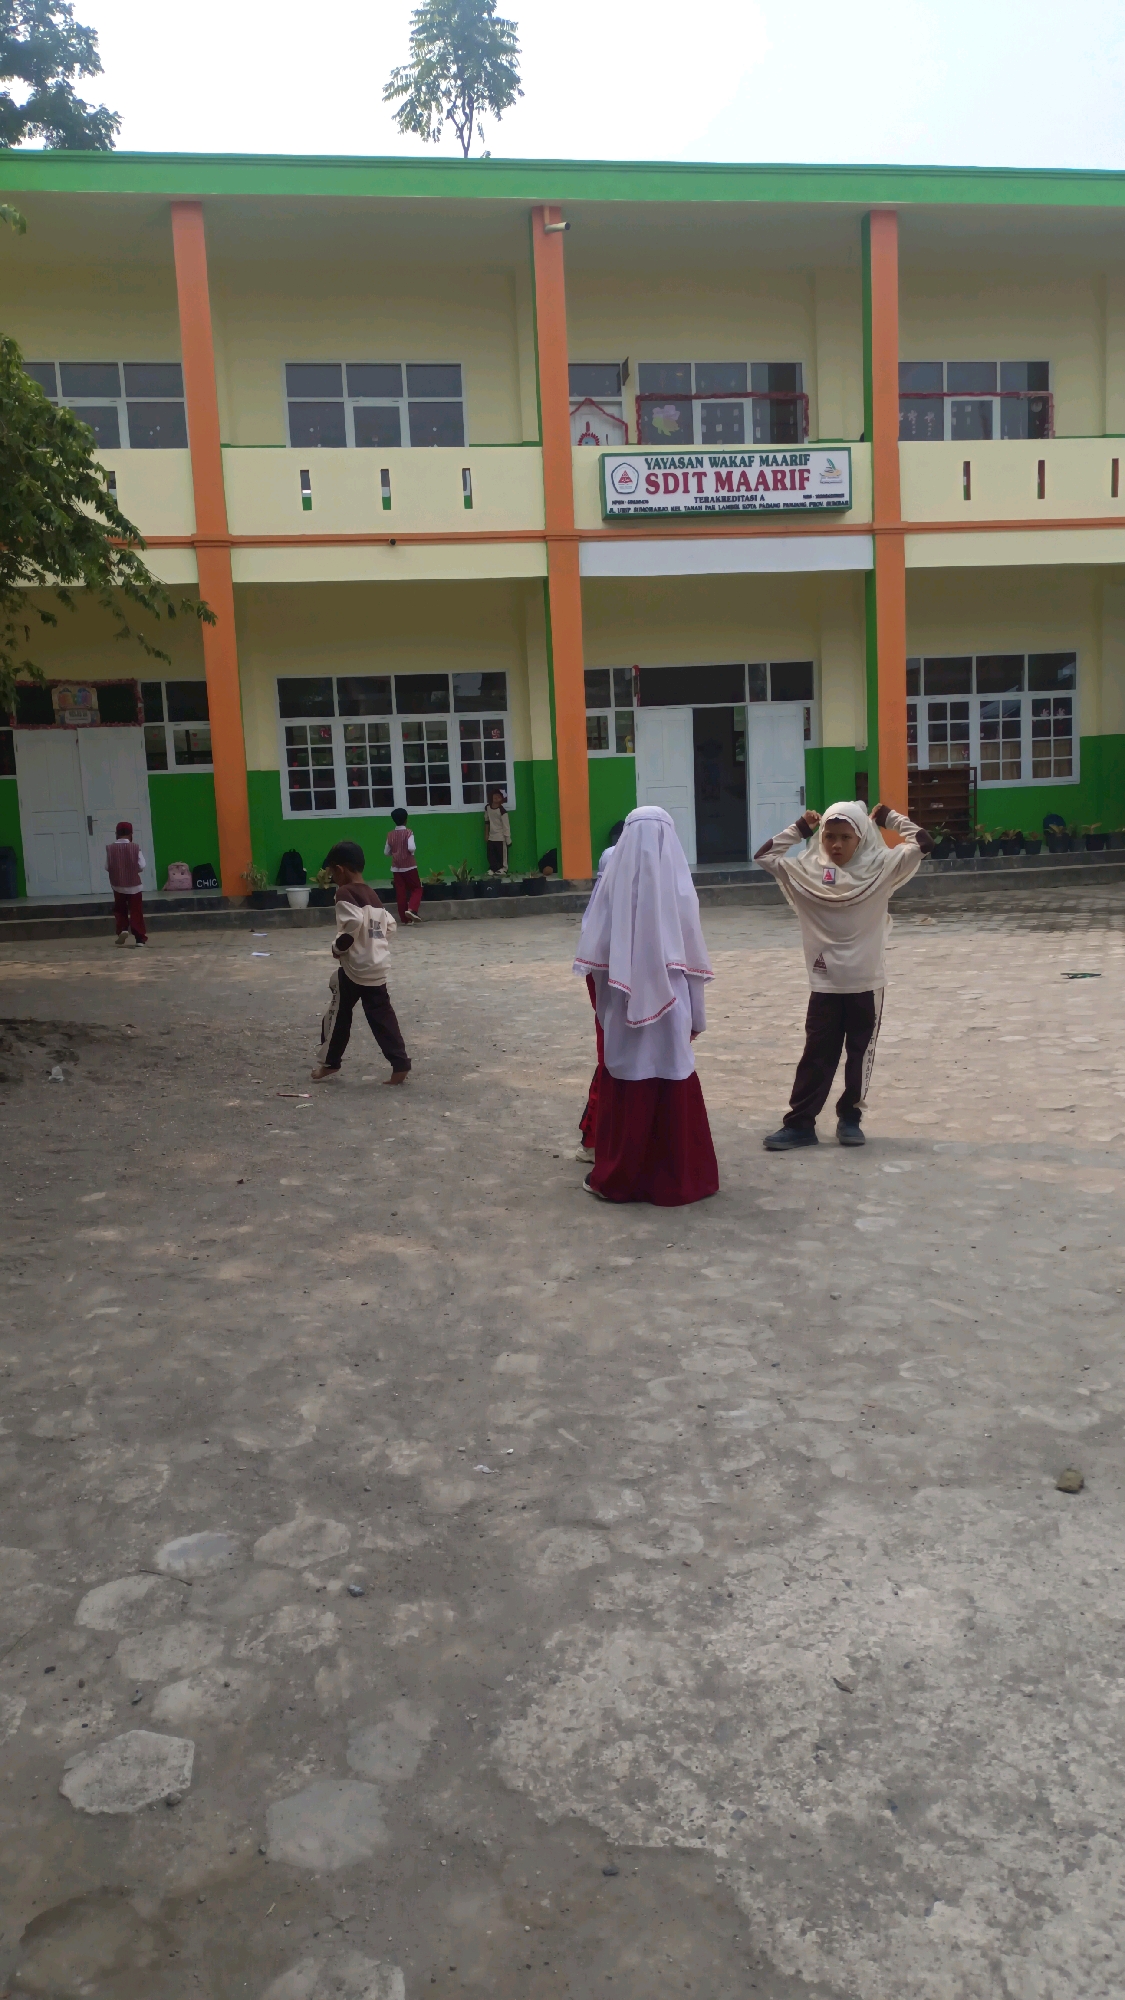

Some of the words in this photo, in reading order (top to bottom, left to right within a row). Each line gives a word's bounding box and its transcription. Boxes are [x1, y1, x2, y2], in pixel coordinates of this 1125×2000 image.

[645, 457, 704, 470] YAYASAN
[708, 455, 755, 468] WAKAF
[759, 454, 810, 467] MAARIF
[645, 471, 707, 495] SDIT
[714, 469, 811, 493] MAARIF
[694, 494, 757, 503] TERAKREDITASI
[196, 878, 218, 888] CHIC
